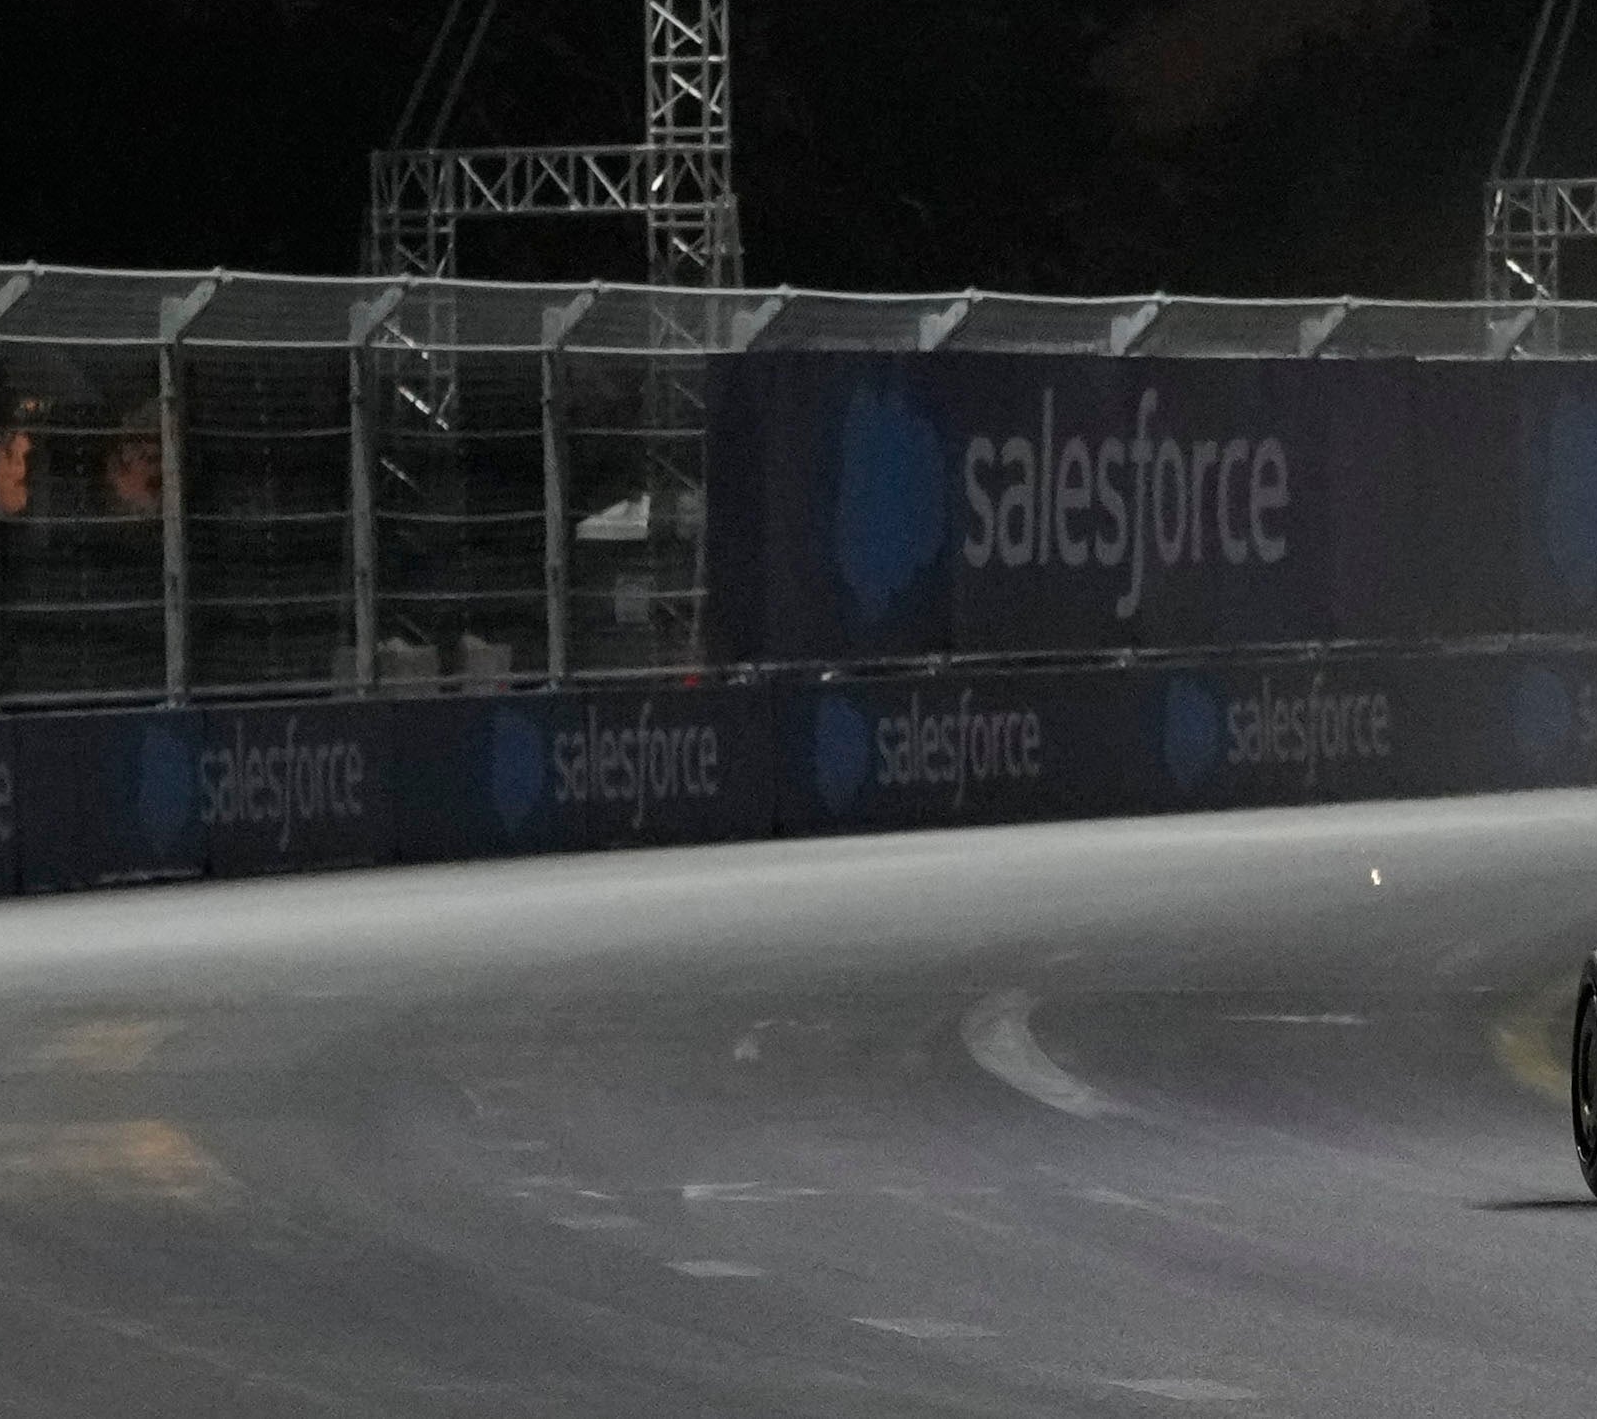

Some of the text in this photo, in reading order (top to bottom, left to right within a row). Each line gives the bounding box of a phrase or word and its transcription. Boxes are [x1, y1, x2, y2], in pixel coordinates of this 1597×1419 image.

[963, 388, 1290, 618] salesforce
[202, 714, 363, 853] salesforce
[554, 700, 721, 830] salesforce
[876, 688, 1041, 809] salesforce
[1227, 671, 1390, 785] salesforce
